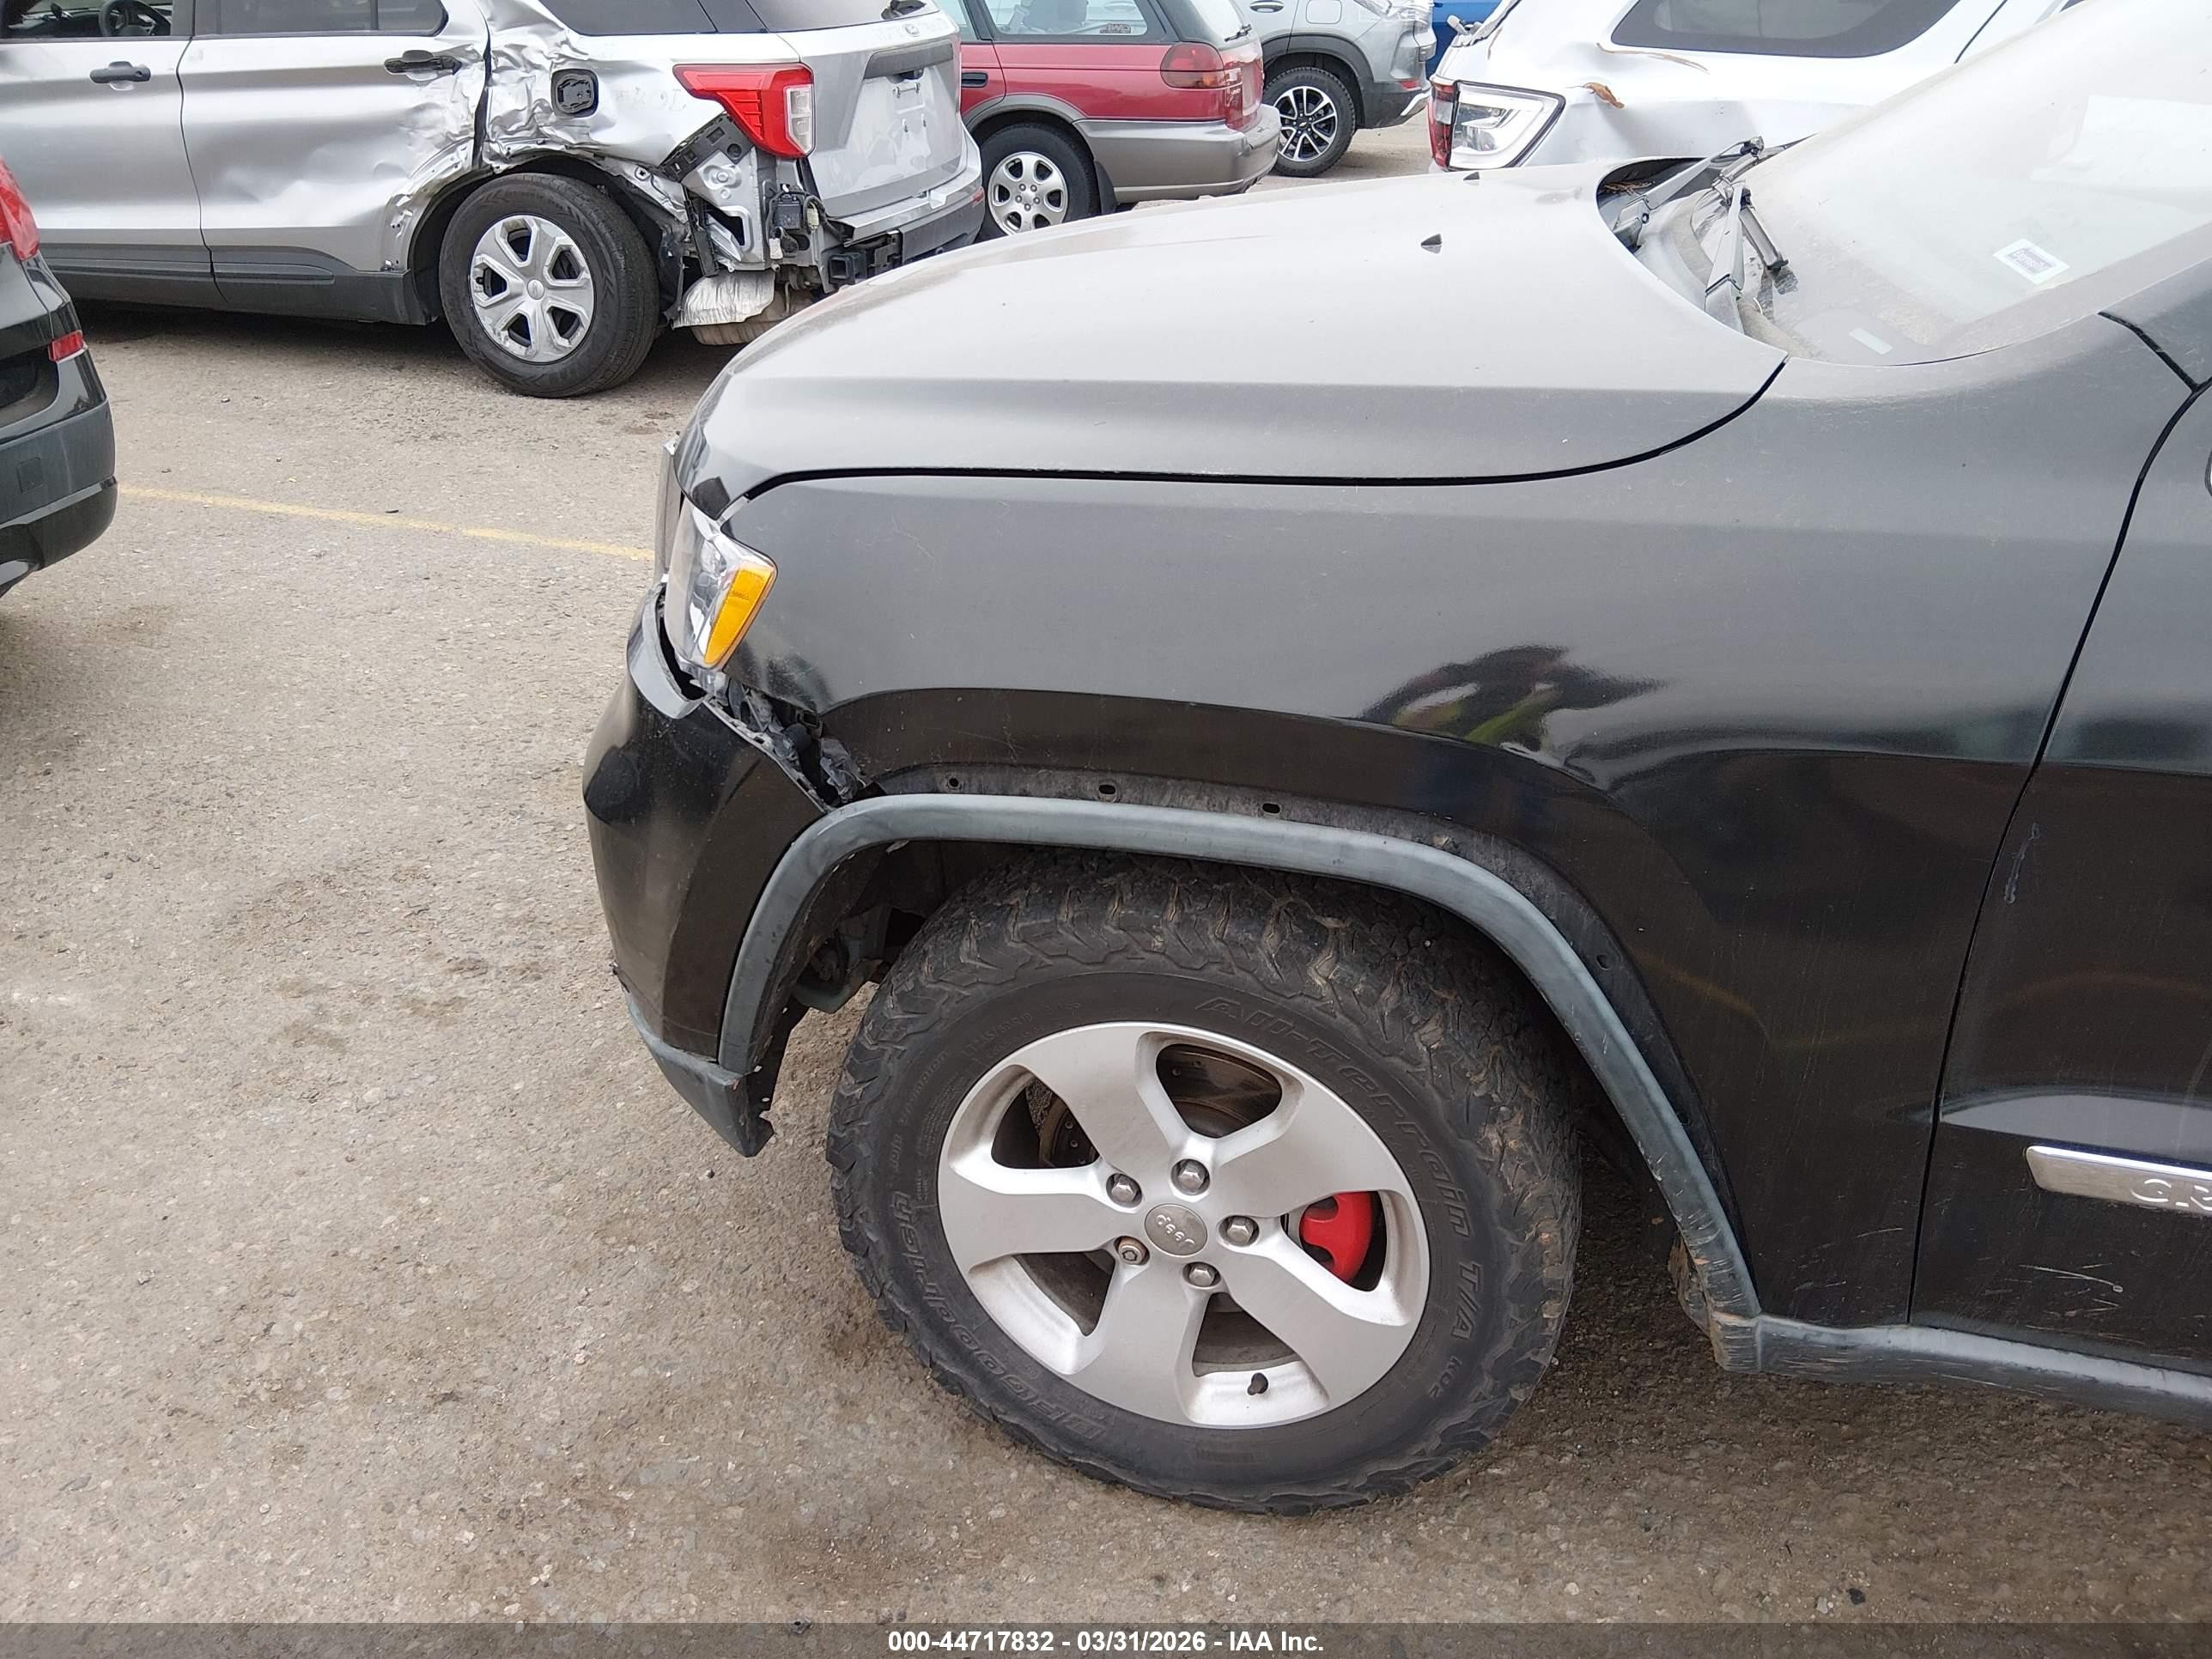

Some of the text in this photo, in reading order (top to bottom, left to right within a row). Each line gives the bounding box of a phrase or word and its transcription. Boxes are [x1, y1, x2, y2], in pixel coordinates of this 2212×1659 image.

[1155, 1213, 1196, 1249] Jeep
[1194, 996, 1472, 1239] All-Terrain
[1451, 1259, 1485, 1341] T/A
[889, 1189, 1108, 1441] BFGoodrich
